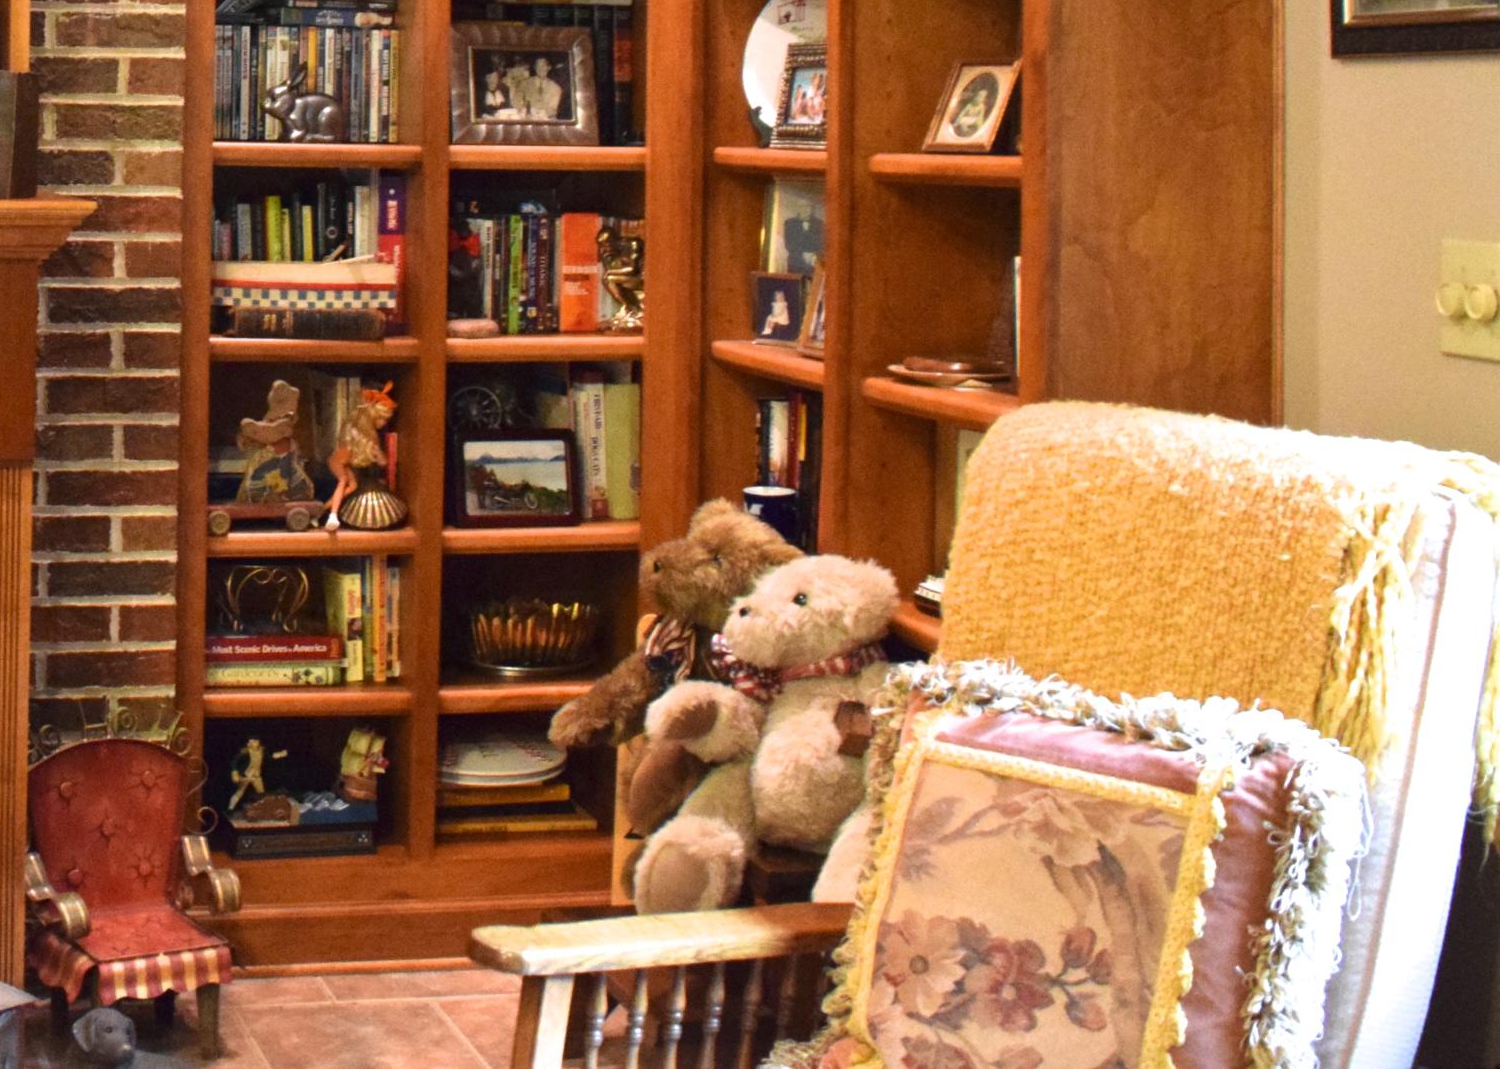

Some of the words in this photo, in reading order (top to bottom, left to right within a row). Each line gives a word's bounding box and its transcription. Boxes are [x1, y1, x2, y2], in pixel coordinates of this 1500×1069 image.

[538, 255, 546, 287] TITANIC
[211, 645, 233, 654] Most
[234, 644, 261, 654] Scenic
[262, 643, 287, 653] Drives
[293, 642, 328, 652] America
